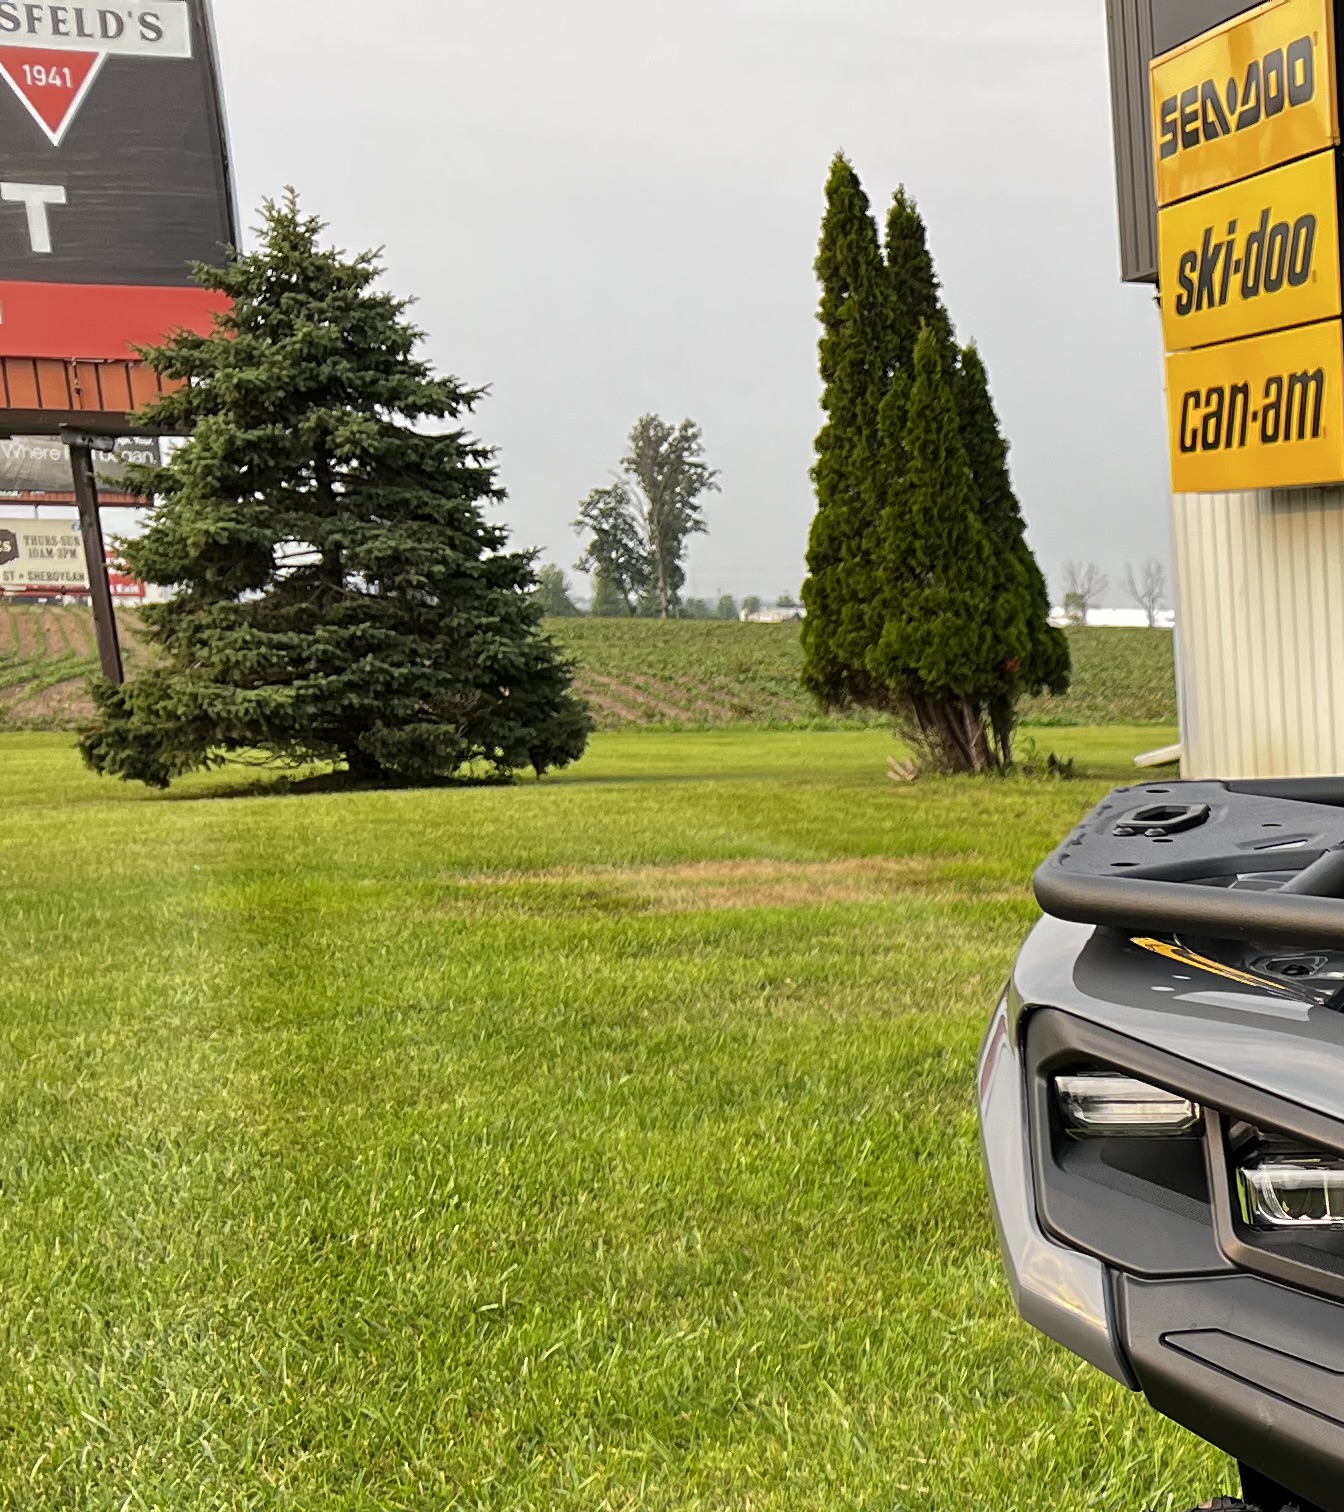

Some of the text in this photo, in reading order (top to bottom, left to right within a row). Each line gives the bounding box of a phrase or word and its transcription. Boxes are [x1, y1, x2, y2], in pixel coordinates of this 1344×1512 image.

[0, 2, 163, 42] SFELD'S
[22, 64, 73, 88] 1941
[1, 182, 67, 253] T
[1176, 207, 1316, 316] ski-doo
[1181, 366, 1324, 453] can-am
